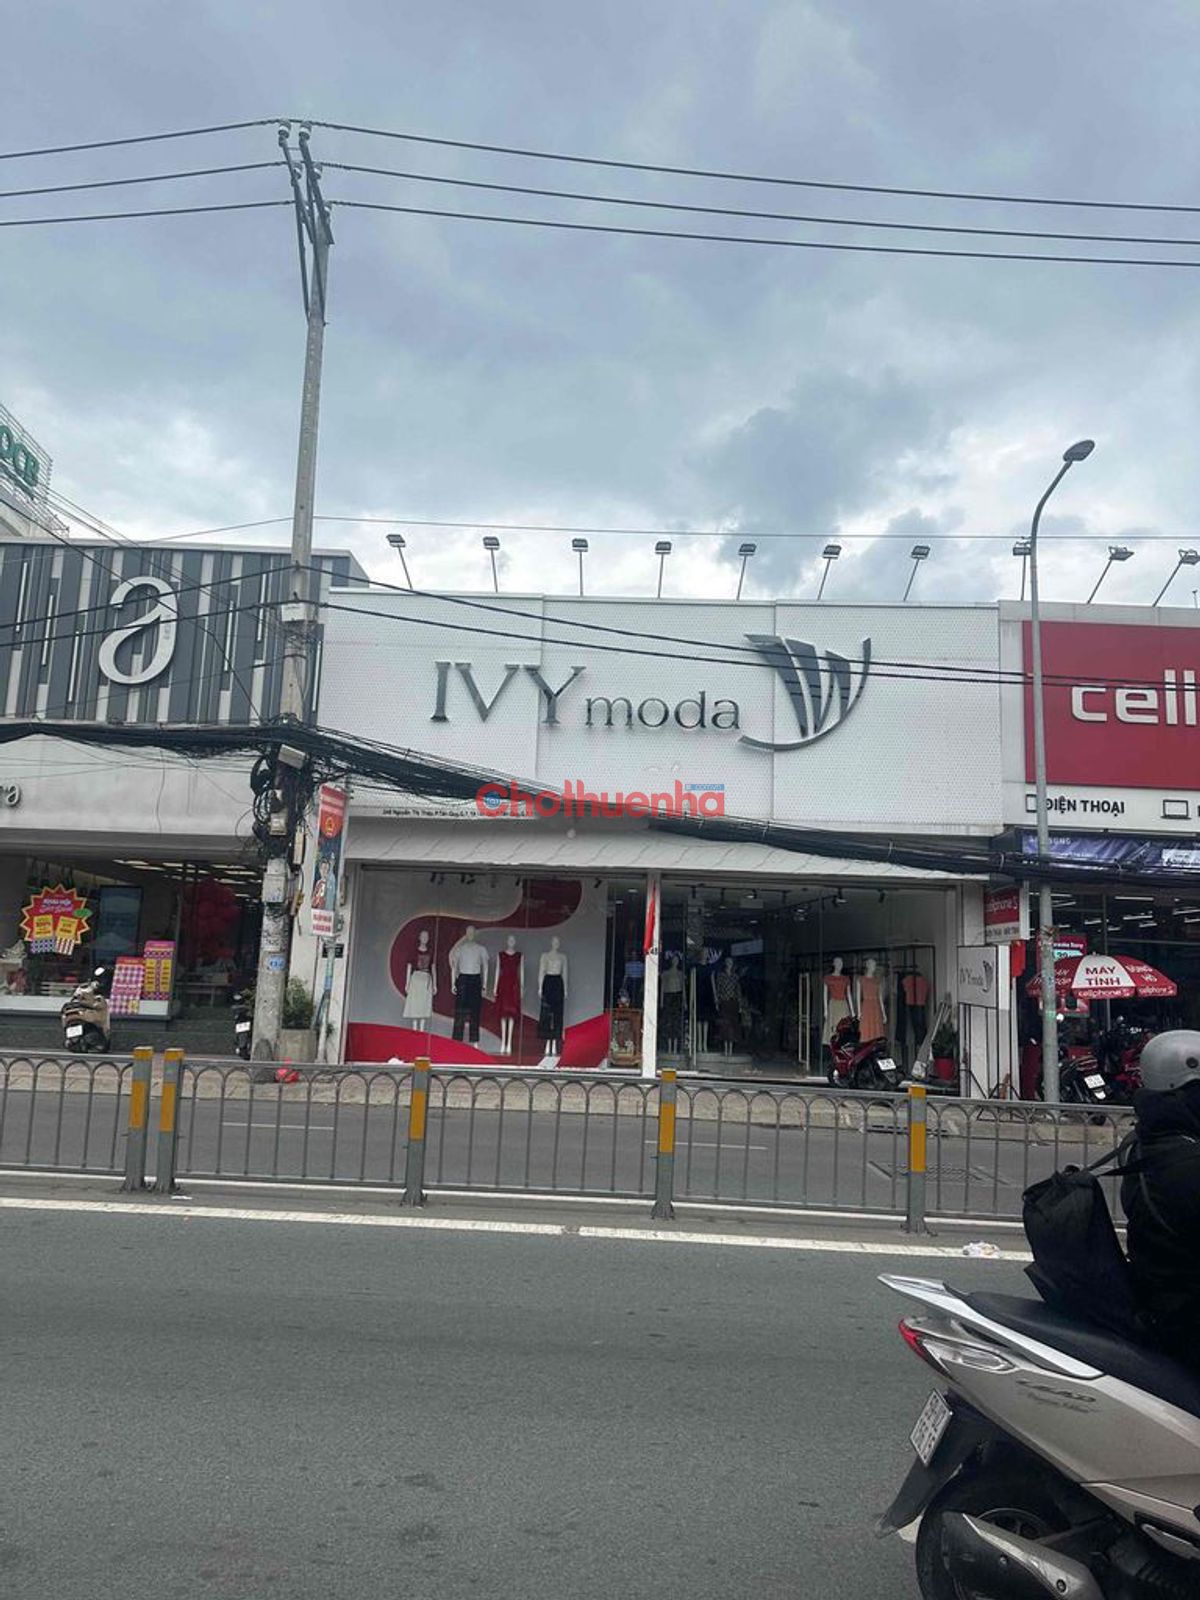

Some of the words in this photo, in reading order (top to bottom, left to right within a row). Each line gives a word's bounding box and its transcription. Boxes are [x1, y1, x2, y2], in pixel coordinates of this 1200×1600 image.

[430, 660, 587, 724] IVY
[585, 690, 741, 730] moda
[1071, 669, 1197, 726] cell
[1080, 800, 1125, 817] THOẠI
[1086, 977, 1121, 986] TÍNH
